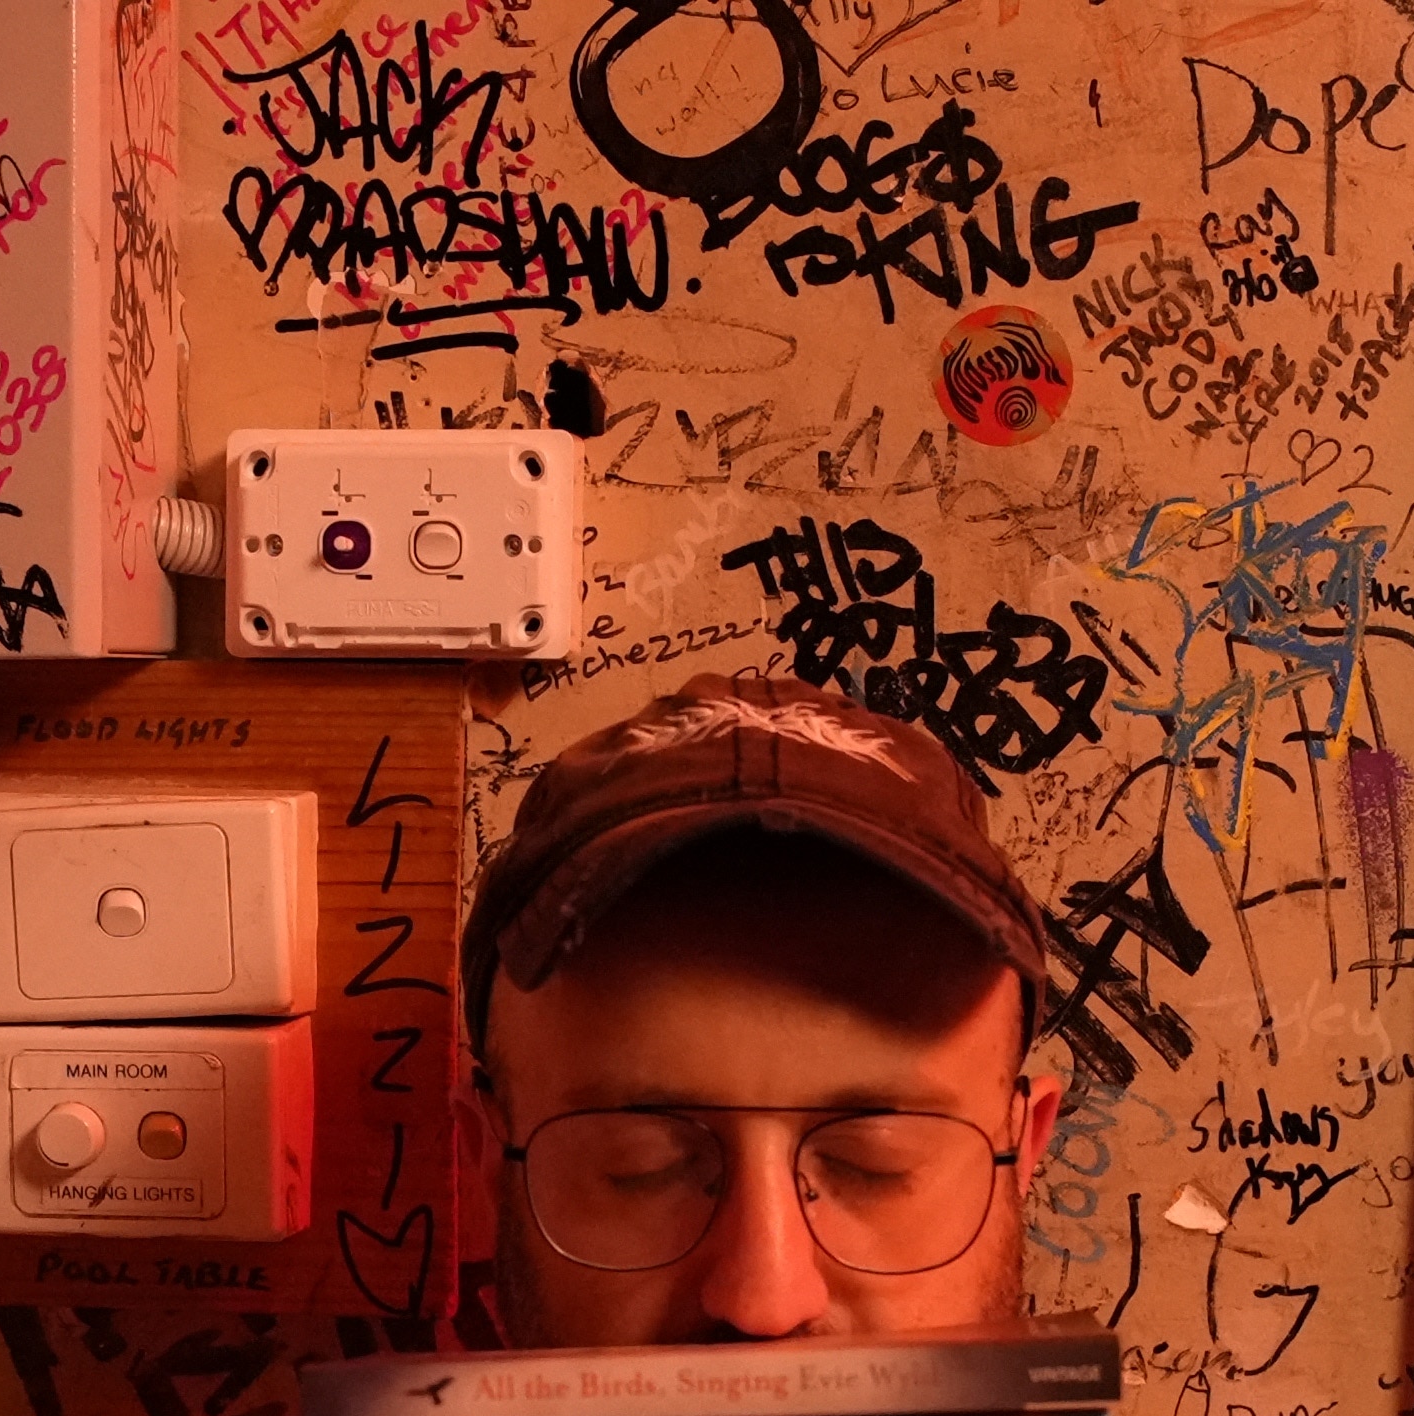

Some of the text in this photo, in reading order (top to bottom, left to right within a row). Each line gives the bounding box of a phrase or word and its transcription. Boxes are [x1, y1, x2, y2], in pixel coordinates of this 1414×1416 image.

[66, 1063, 169, 1080] MAIN ROOM
[48, 1184, 196, 1205] HANGING LIGHTS
[35, 1252, 273, 1292] POOL TABLE
[523, 1374, 570, 1400] the
